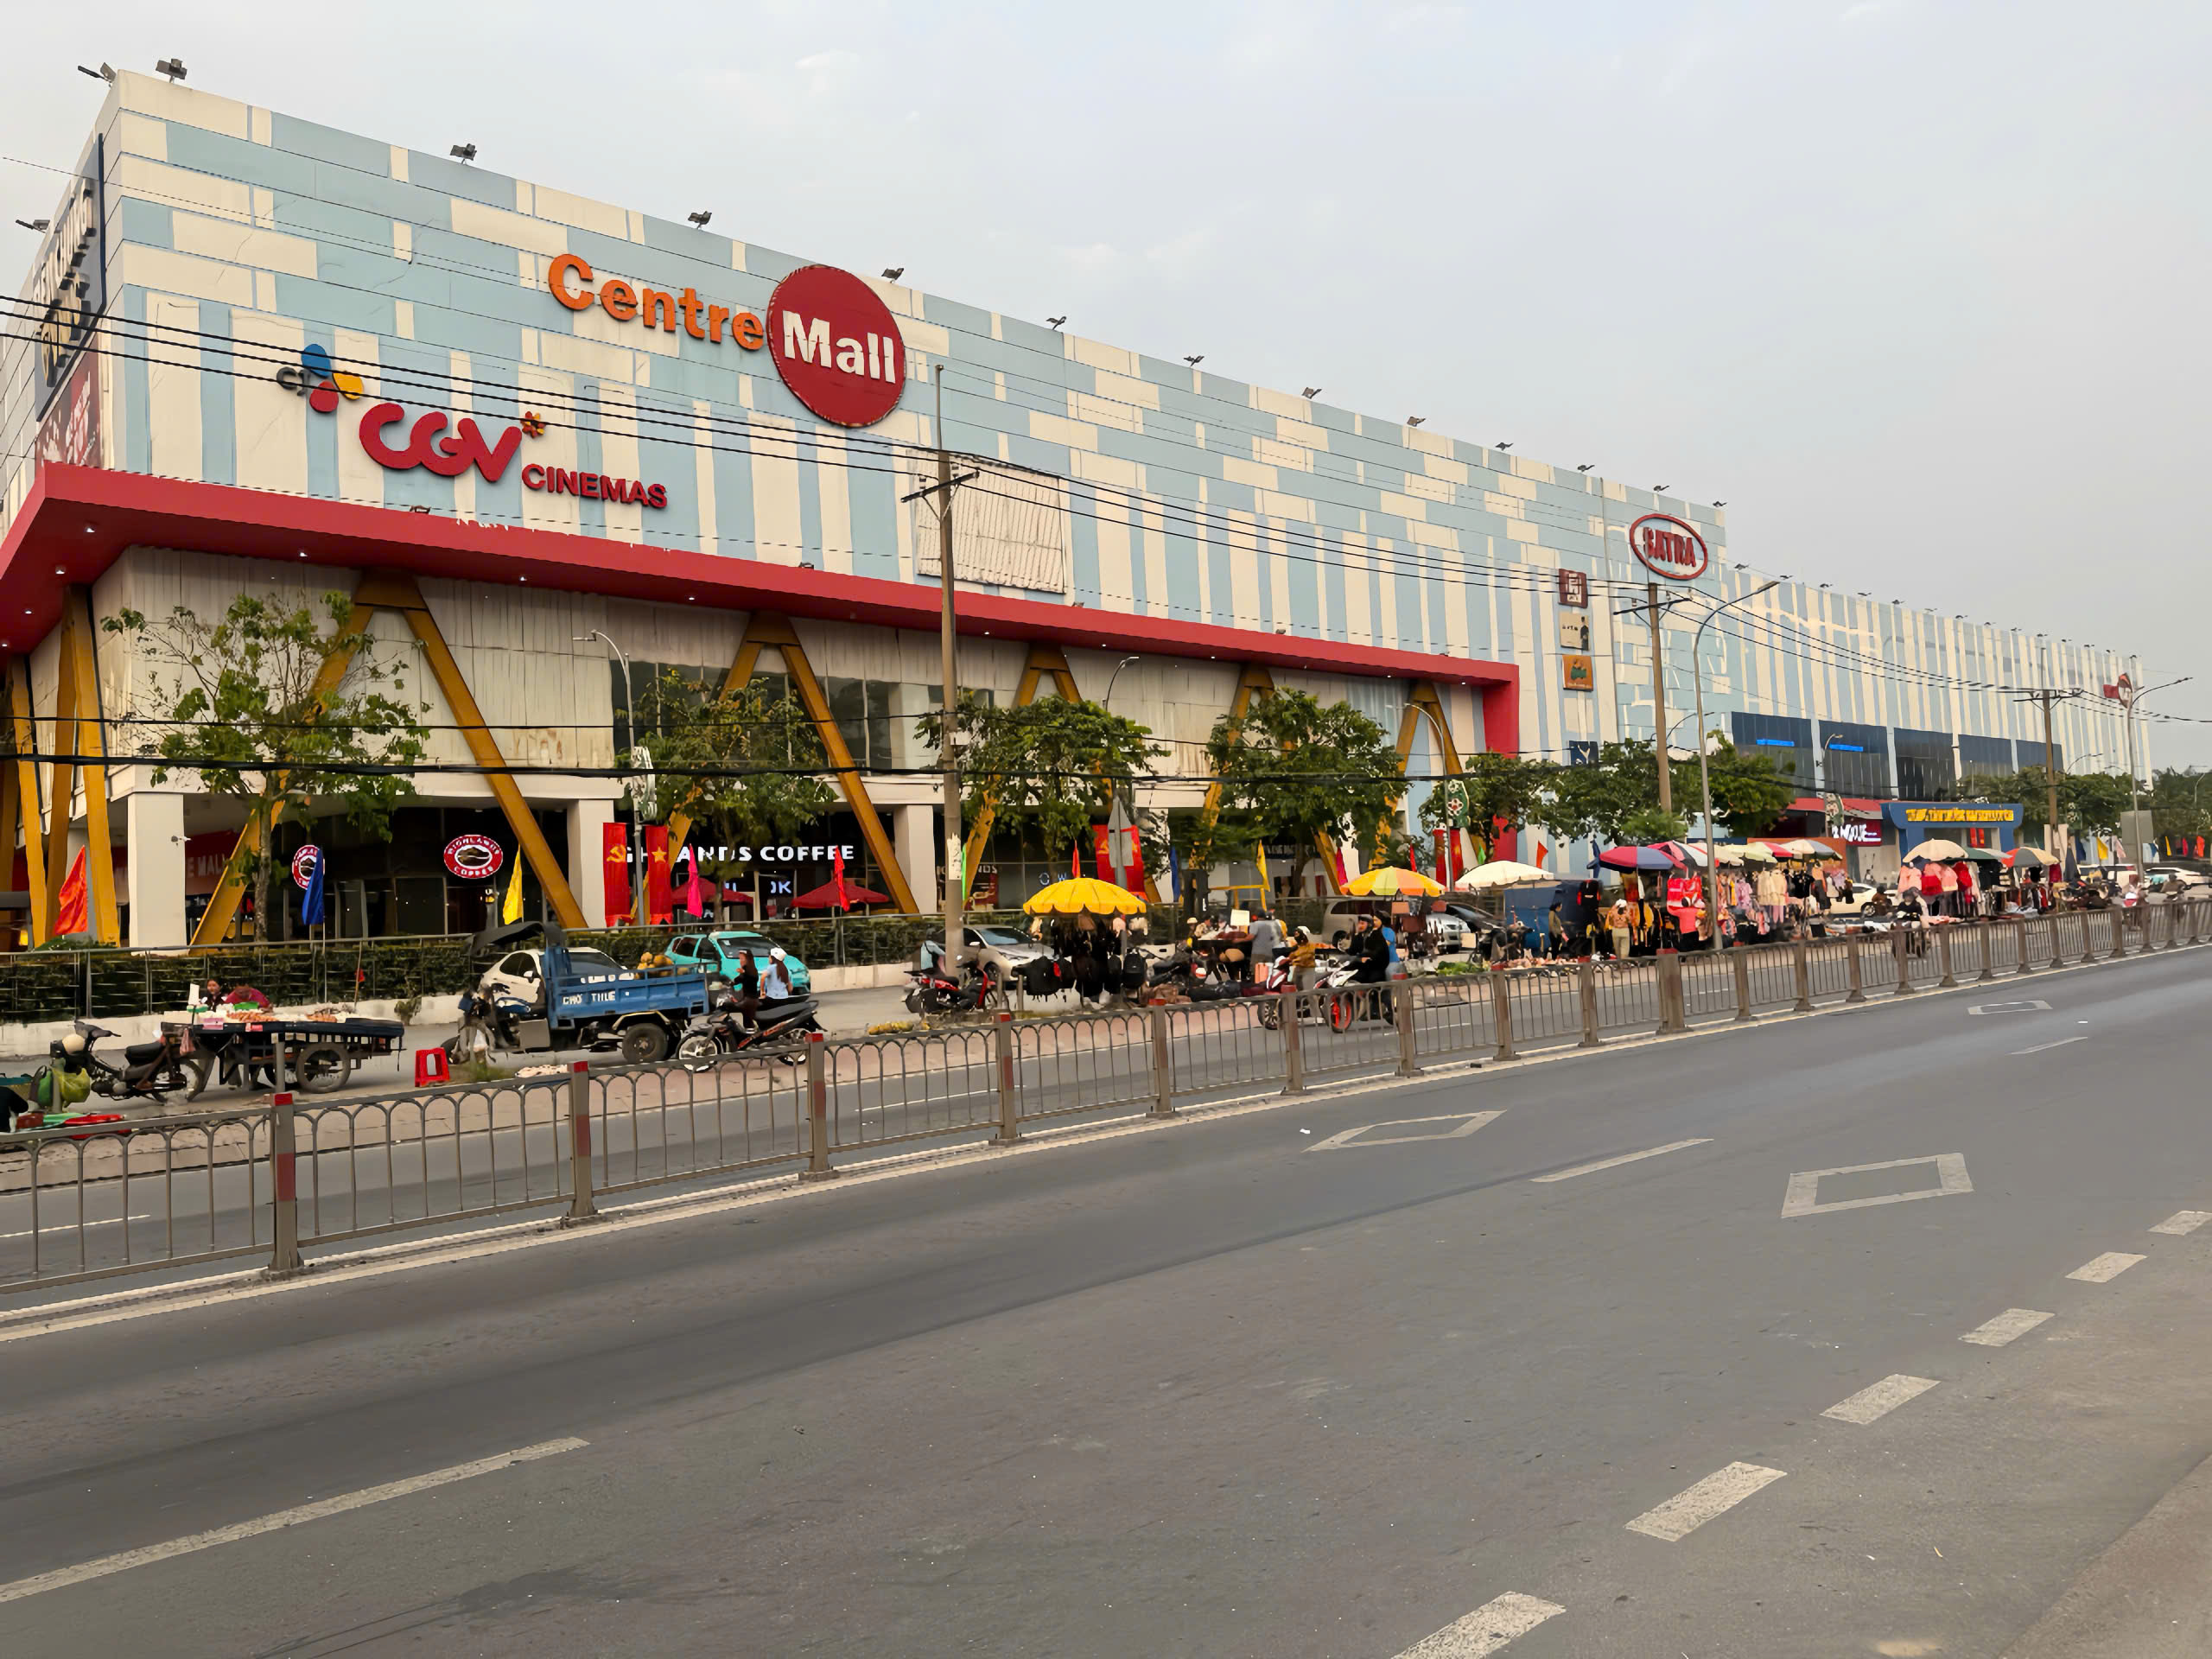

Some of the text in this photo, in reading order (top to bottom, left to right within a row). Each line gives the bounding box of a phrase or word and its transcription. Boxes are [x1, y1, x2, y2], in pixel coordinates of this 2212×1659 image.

[548, 252, 897, 385] Centre Mall
[359, 402, 523, 484] CGV
[521, 462, 669, 510] CINEMAS
[1642, 526, 1697, 568] SATRA
[760, 844, 855, 861] COFFEE
